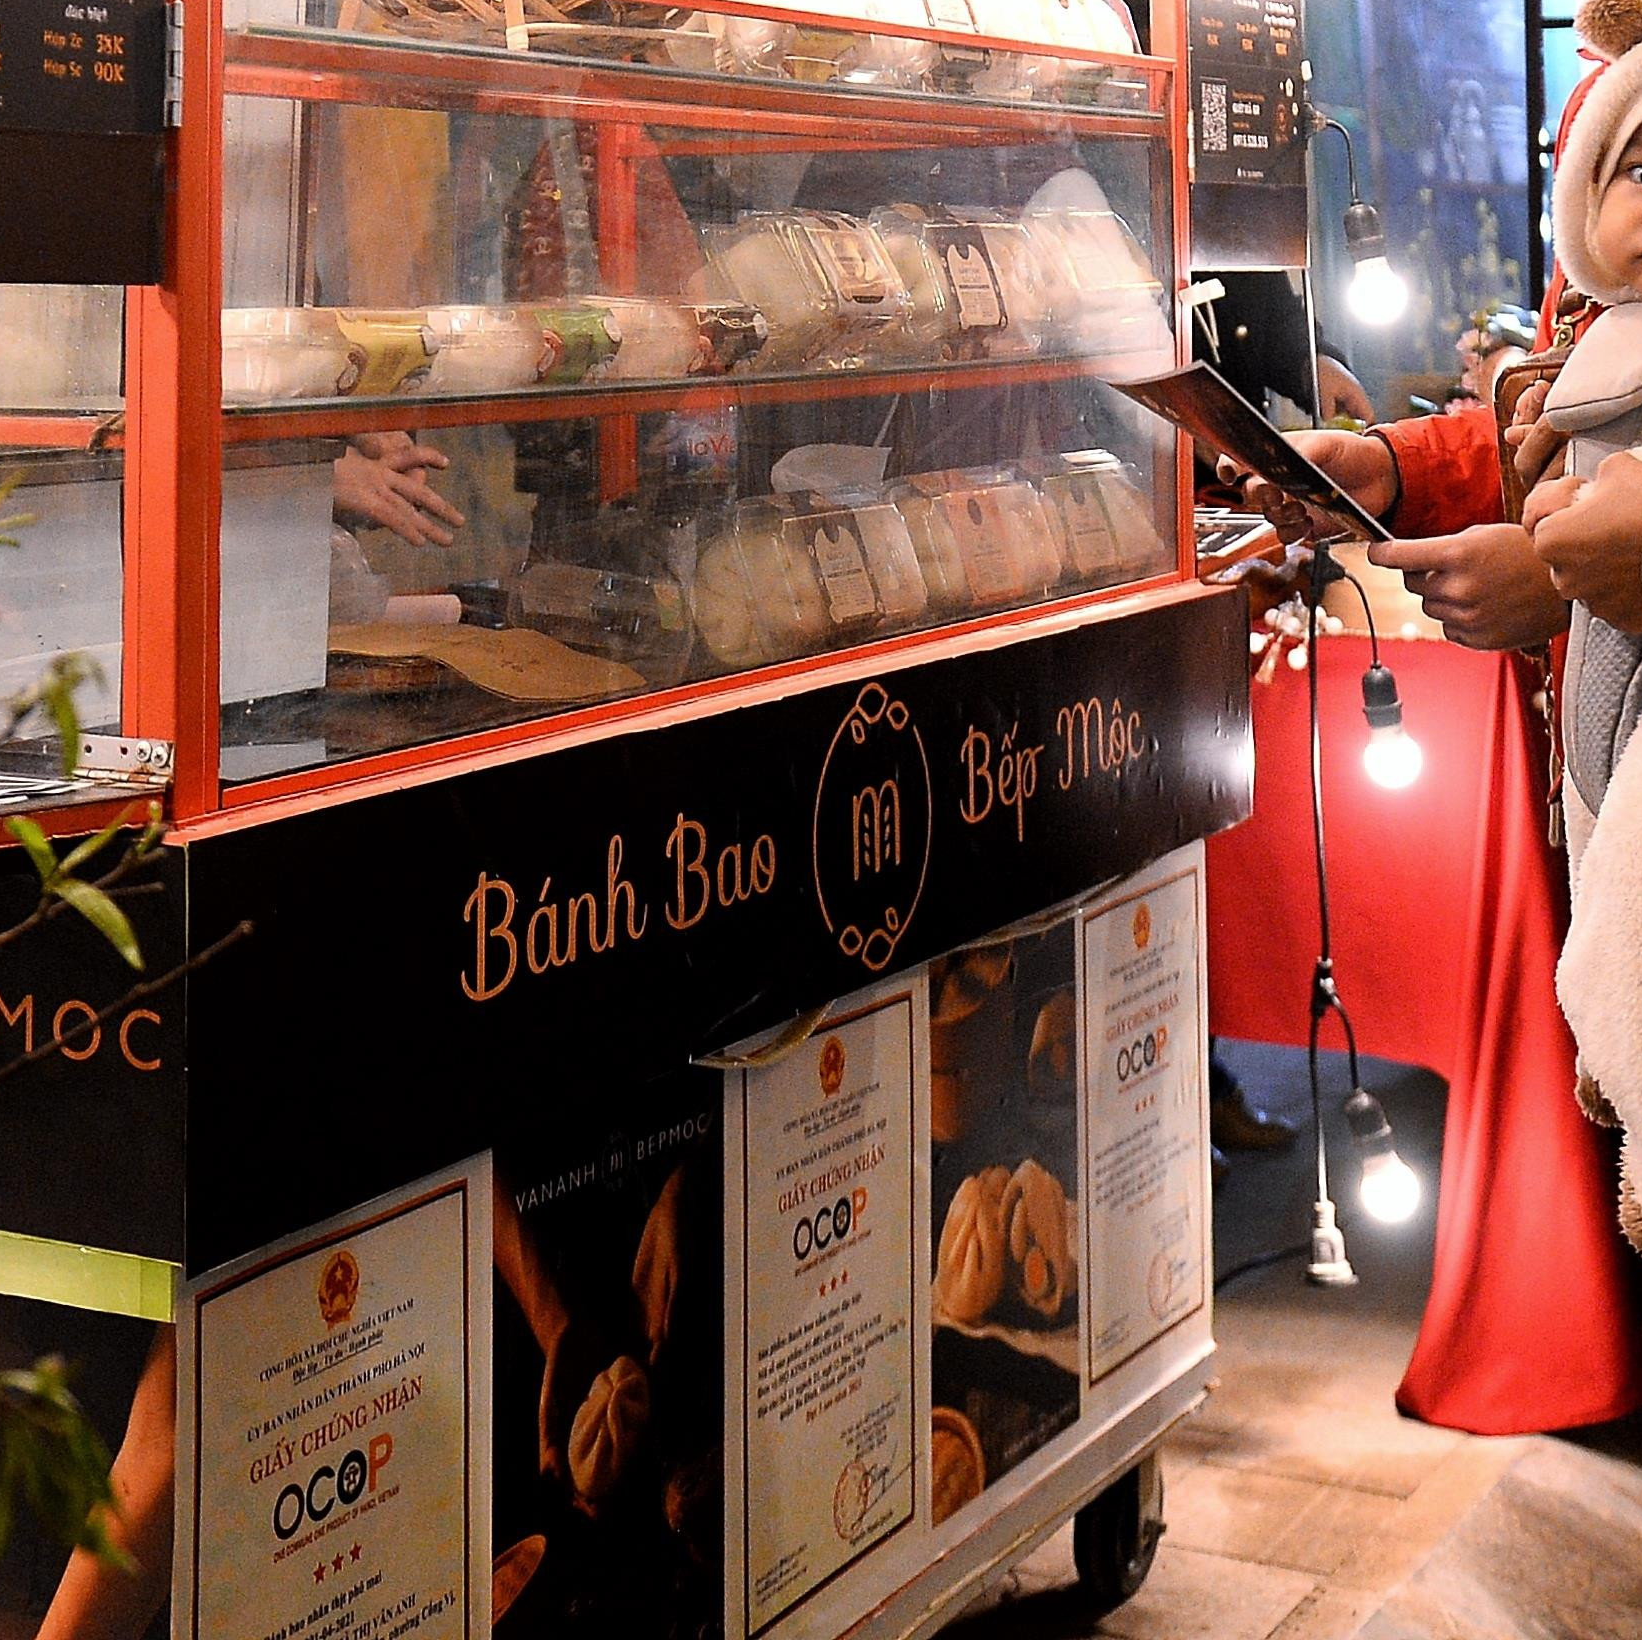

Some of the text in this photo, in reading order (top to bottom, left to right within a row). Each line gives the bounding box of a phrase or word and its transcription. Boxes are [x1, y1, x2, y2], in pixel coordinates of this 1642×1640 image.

[93, 60, 126, 83] 90K
[459, 832, 648, 1004] Bánh
[664, 812, 777, 931] Bao
[957, 722, 1047, 843] Bếp
[1055, 696, 1147, 793] Mộc
[1116, 1024, 1168, 1082] OCOP
[515, 1112, 709, 1214] VANANH BEPMOC
[793, 1186, 868, 1261] OCOP
[248, 1374, 424, 1486] GIẤY CHỨNG NHẬN
[273, 1431, 395, 1541] OCOP
[393, 1592, 417, 1618] ANH
